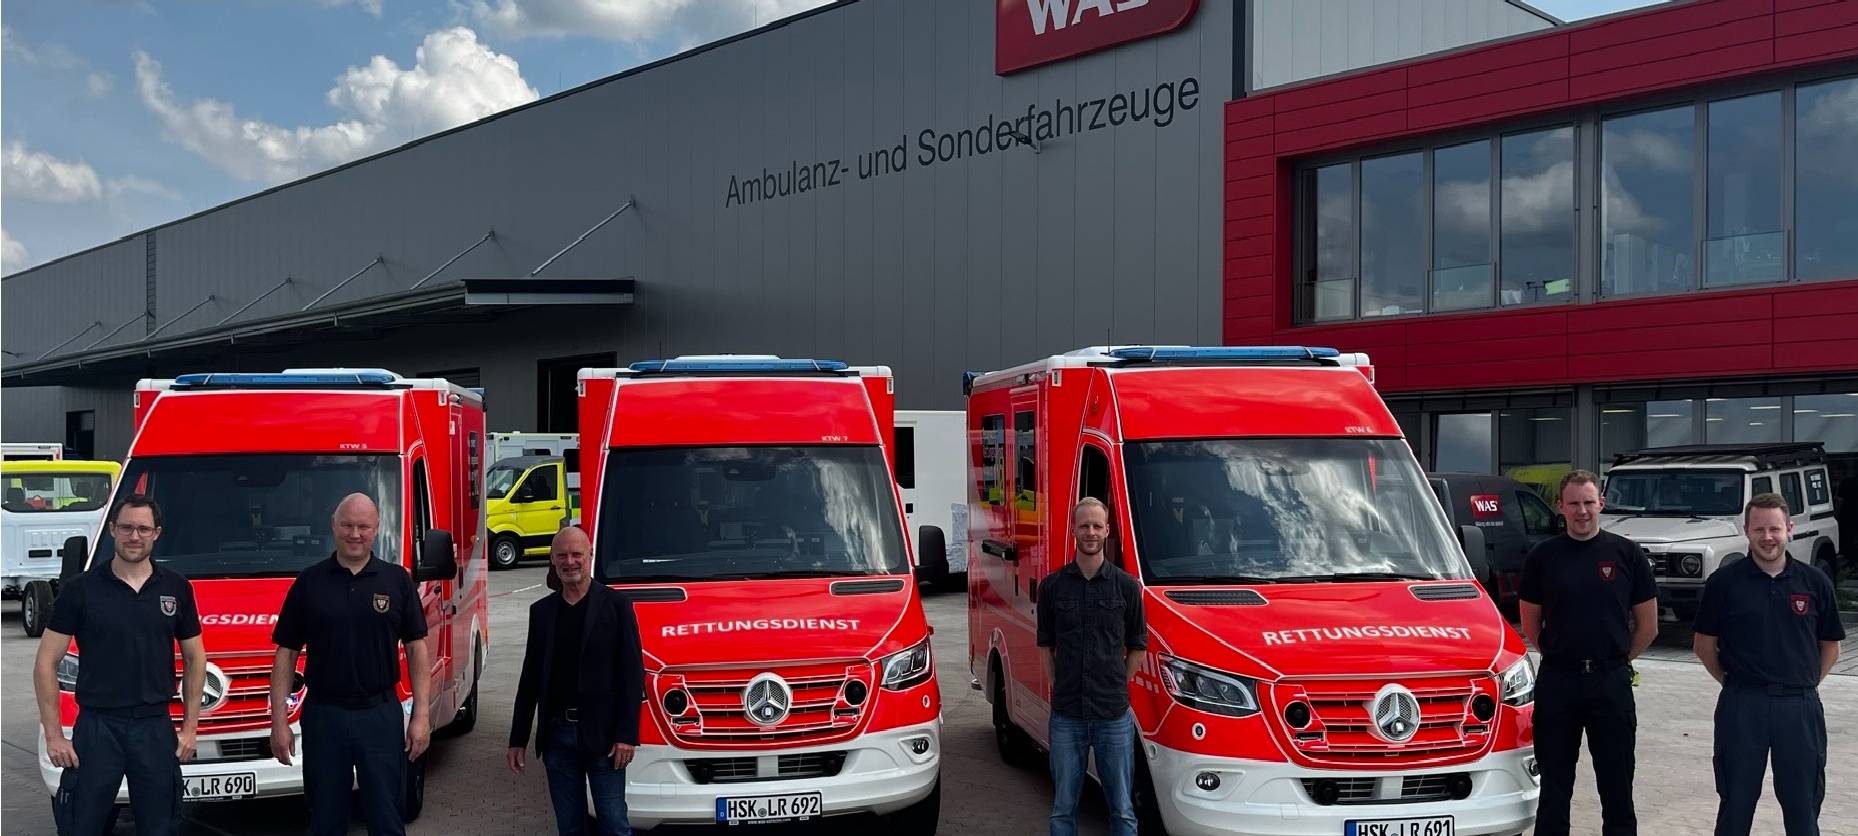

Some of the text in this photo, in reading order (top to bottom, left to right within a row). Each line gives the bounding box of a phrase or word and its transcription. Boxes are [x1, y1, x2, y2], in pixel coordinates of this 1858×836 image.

[726, 77, 1200, 208] Ambulanz- und Sonderfahrzeuge
[1474, 500, 1498, 512] WAS
[661, 619, 860, 637] RETTUNGSDIENST
[1262, 626, 1471, 645] RETTUNGSDIENST
[201, 778, 220, 796] LR
[225, 776, 252, 793] 690
[728, 800, 757, 818] HSK
[767, 798, 788, 817] LR
[791, 796, 819, 816] 692
[1358, 824, 1389, 836] HSK
[1424, 819, 1451, 836] 691
